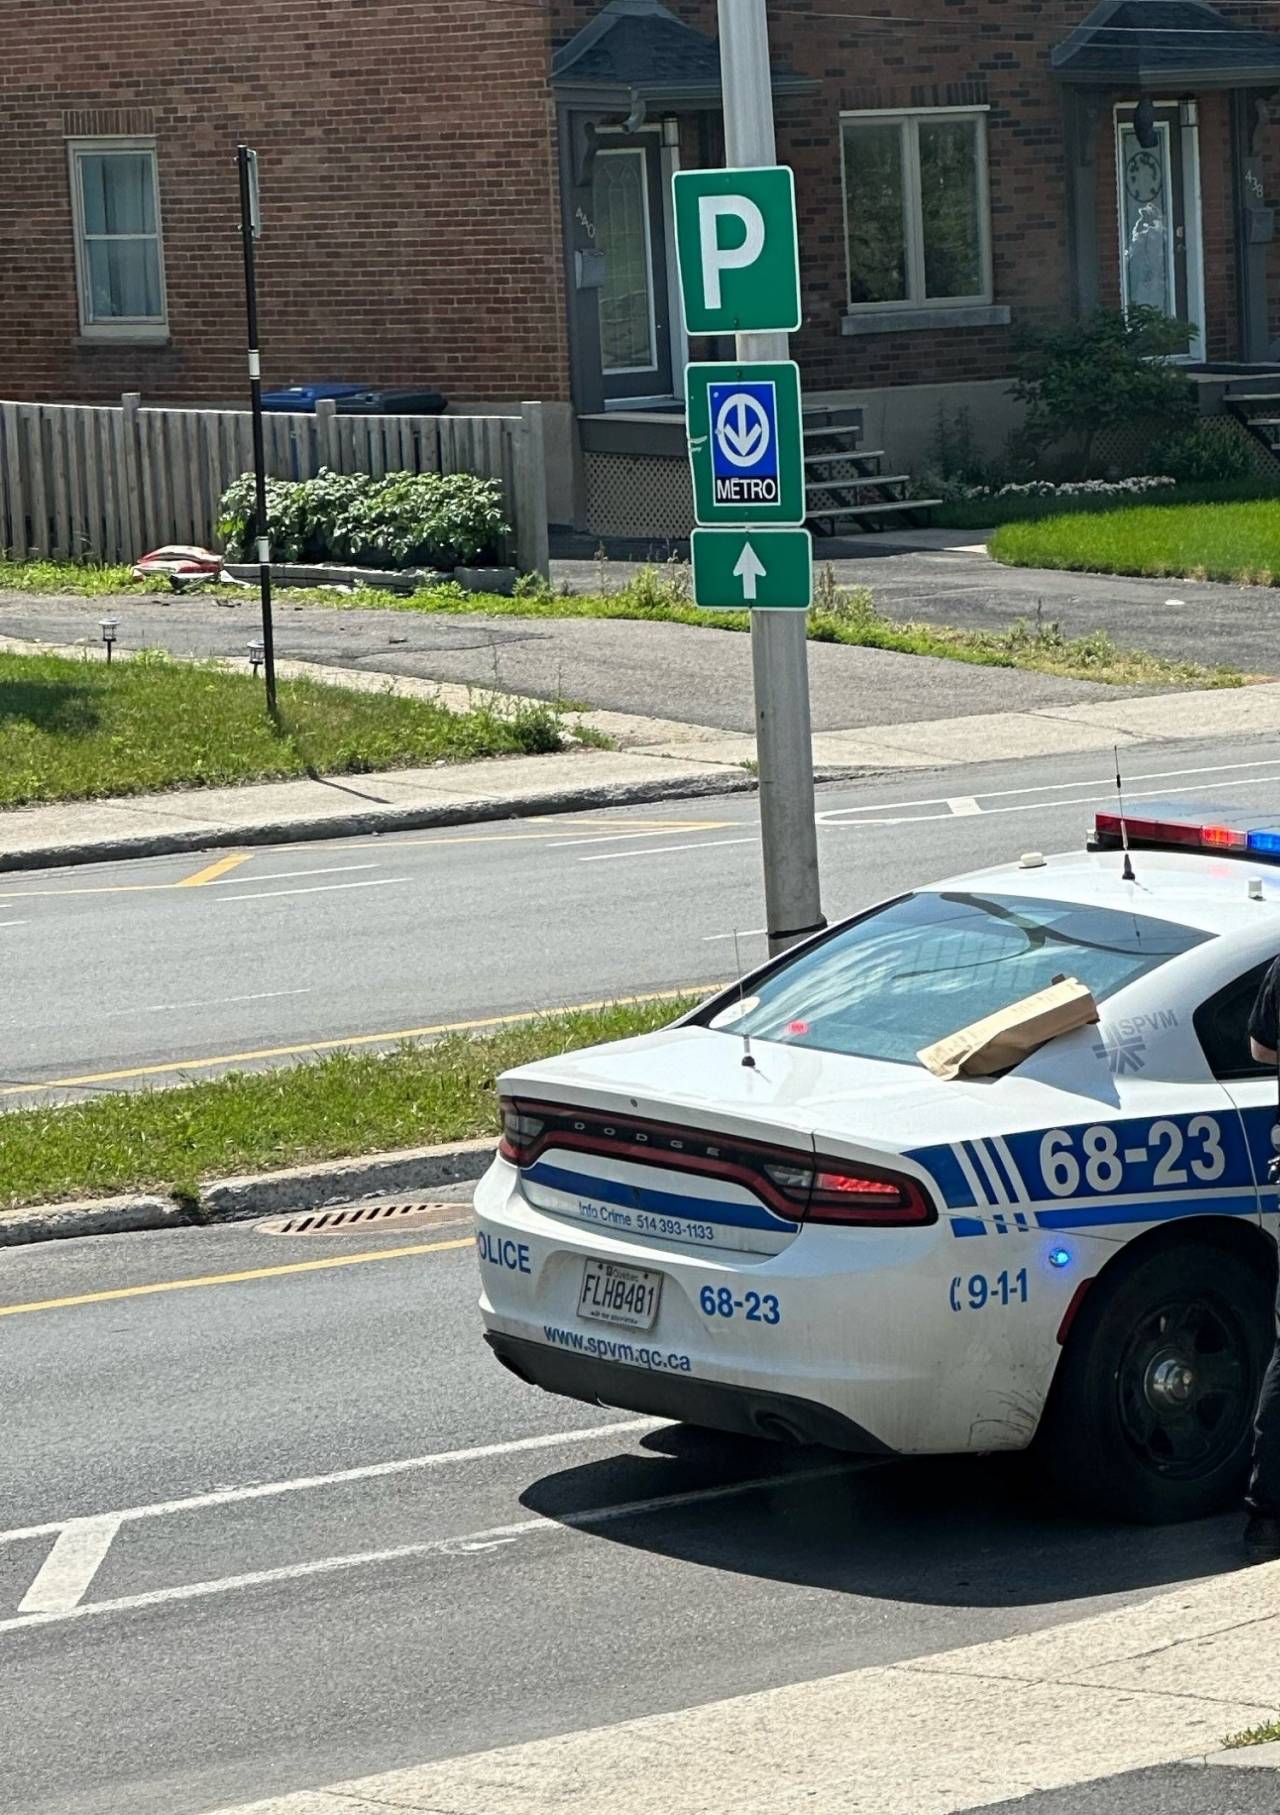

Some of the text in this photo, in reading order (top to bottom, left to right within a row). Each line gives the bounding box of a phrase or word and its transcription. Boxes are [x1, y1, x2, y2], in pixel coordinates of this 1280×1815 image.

[1244, 169, 1263, 198] 438
[575, 206, 596, 239] 440
[698, 194, 765, 310] P
[1119, 1009, 1178, 1036] SPVM
[574, 1121, 721, 1157] DODGE
[1039, 1115, 1226, 1197] 68-23
[578, 1200, 715, 1241] Info Crime 514 393-1133
[479, 1231, 531, 1275] OLICE
[582, 1273, 655, 1316] FLH8481
[700, 1285, 781, 1326] 68-23
[967, 1267, 1029, 1310] 9-1-1
[543, 1325, 692, 1372] www.spvm.qc.ca
